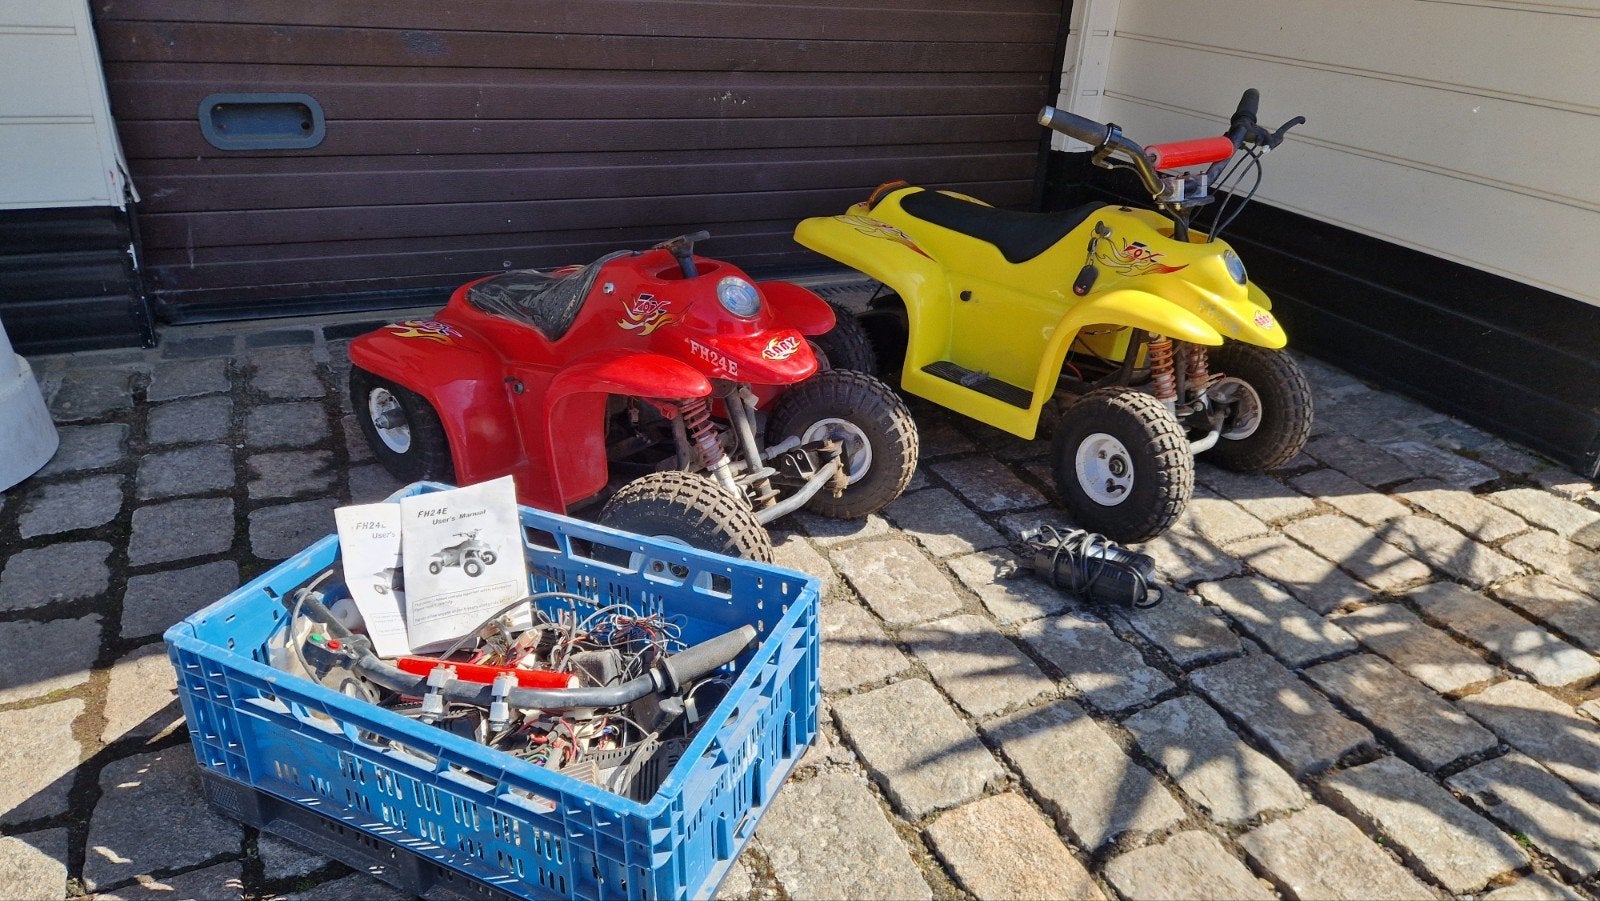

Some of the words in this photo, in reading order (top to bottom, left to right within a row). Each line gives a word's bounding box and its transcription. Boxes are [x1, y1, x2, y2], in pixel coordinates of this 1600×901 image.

[689, 339, 738, 377] FH24E
[417, 507, 448, 518] FH24E
[432, 515, 456, 525] User's
[458, 509, 486, 519] Manual
